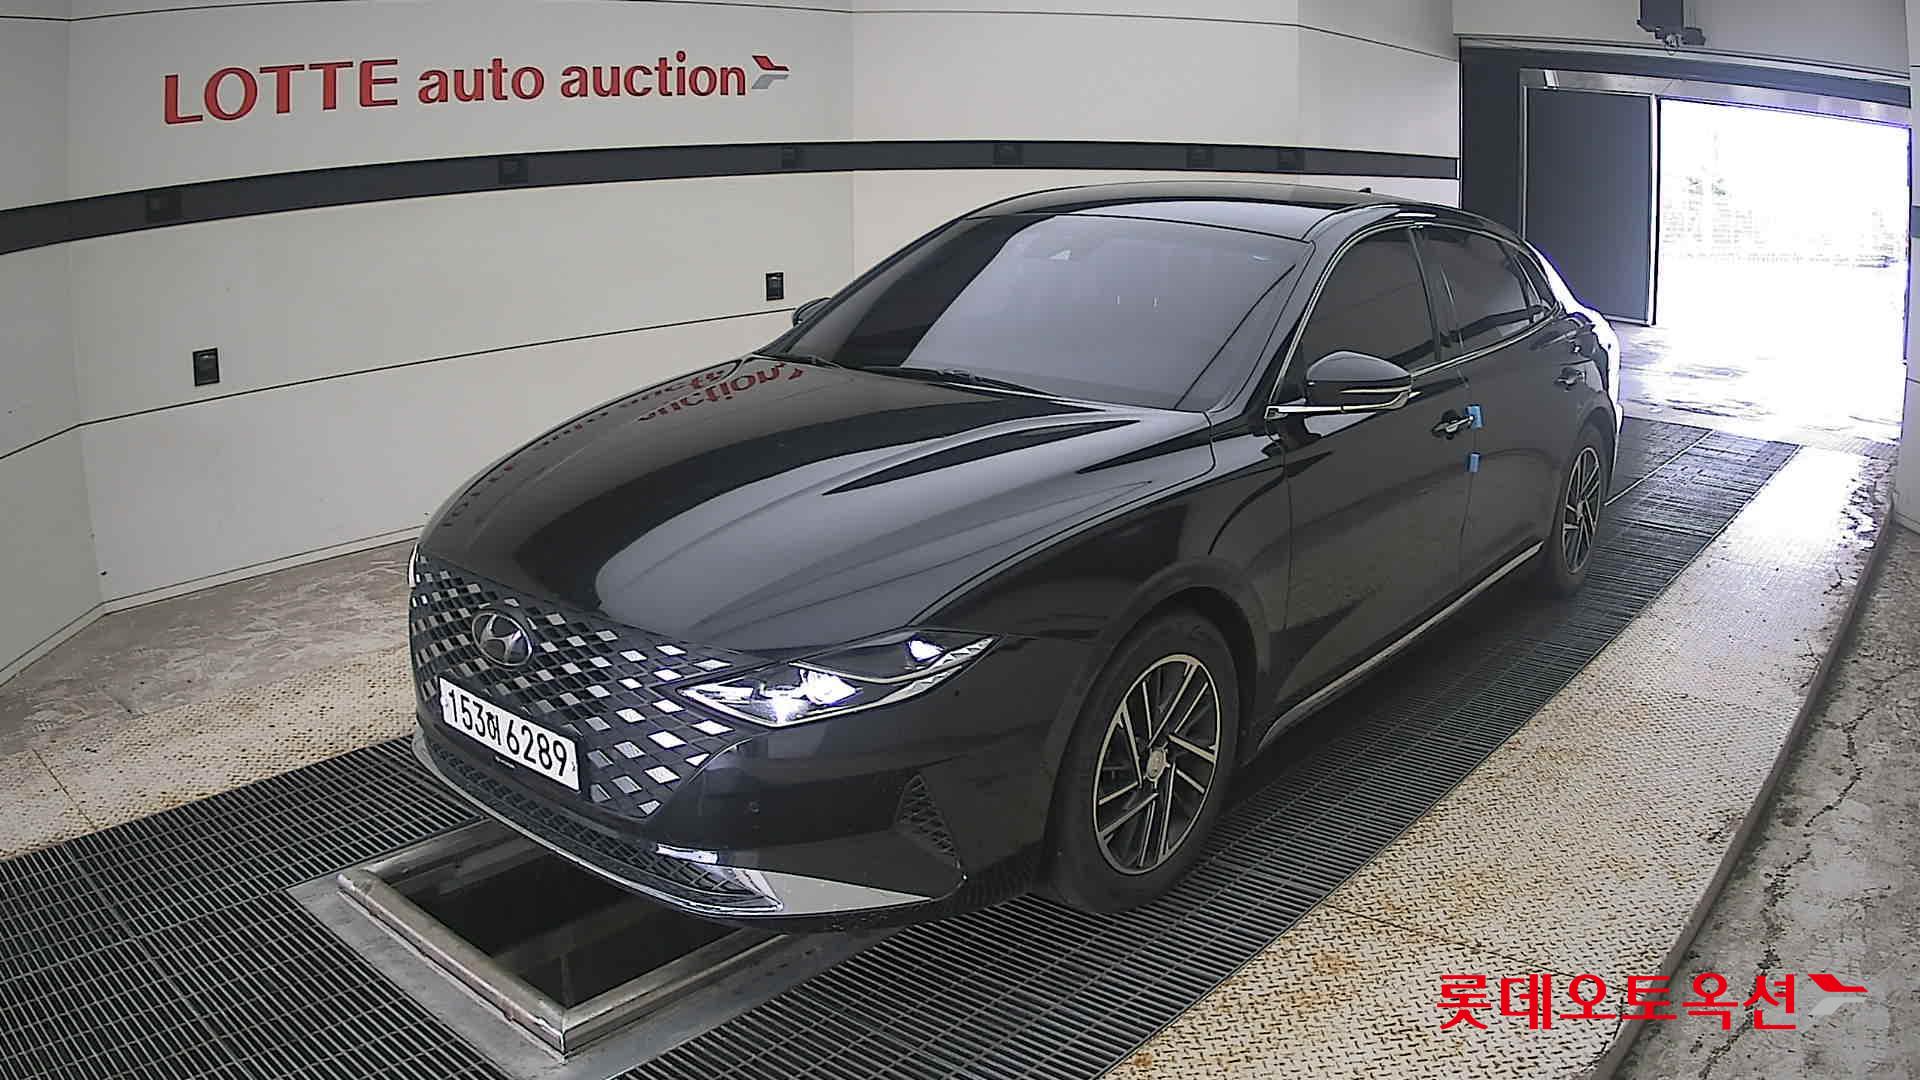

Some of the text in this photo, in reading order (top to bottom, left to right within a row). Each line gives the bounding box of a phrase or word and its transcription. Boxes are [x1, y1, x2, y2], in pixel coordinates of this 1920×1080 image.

[164, 50, 747, 126] LOTTE auto auction
[506, 719, 568, 777] 6289
